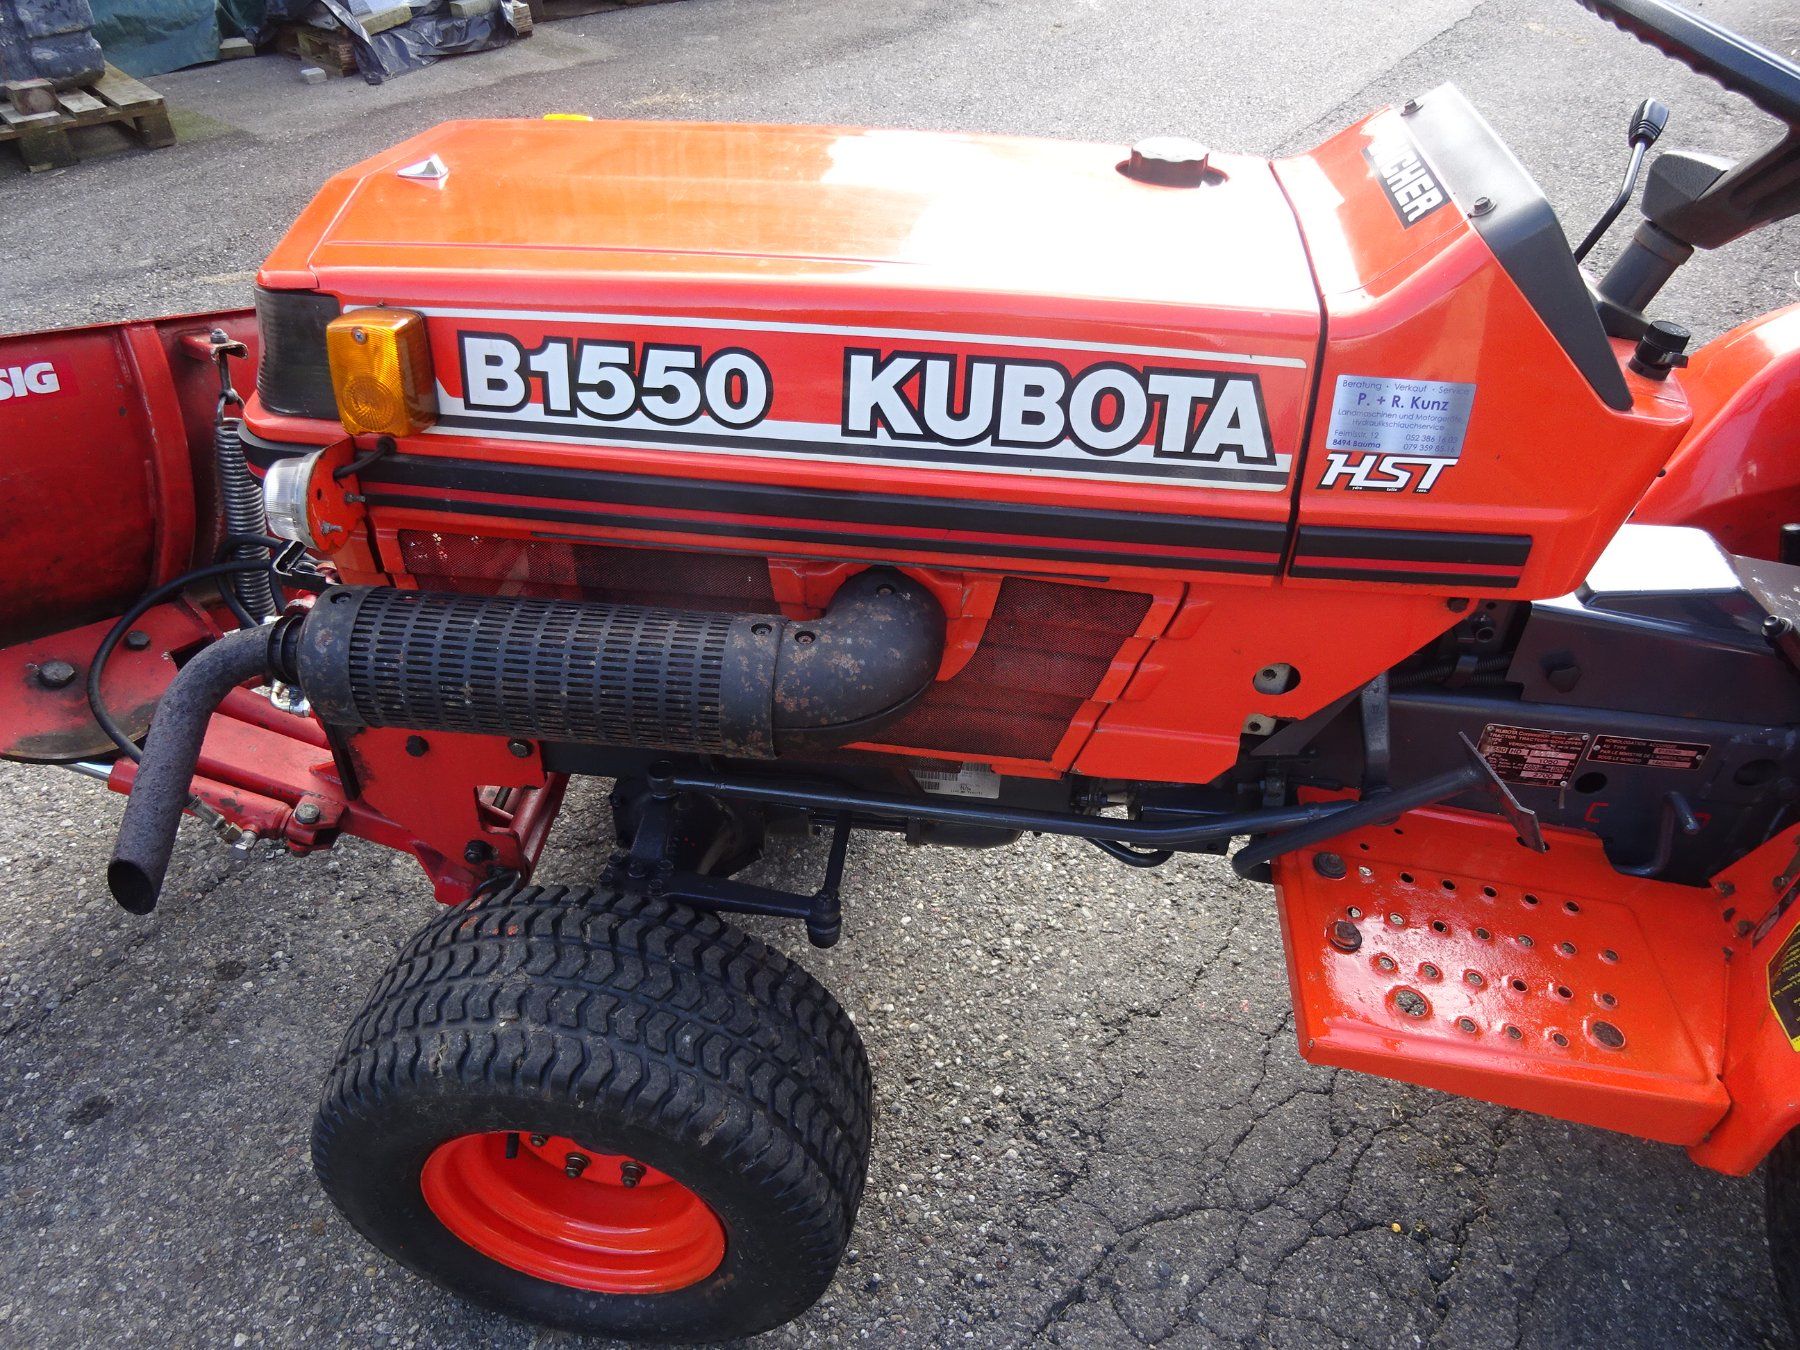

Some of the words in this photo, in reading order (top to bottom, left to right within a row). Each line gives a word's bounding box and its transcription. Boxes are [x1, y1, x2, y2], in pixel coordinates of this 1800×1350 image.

[1369, 138, 1444, 222] CHER
[1342, 379, 1382, 391] Beratung
[1394, 382, 1427, 393] Verkauf
[1438, 385, 1470, 396] Service
[457, 330, 773, 430] B1550
[842, 347, 1277, 466] KUBOTA
[1357, 392, 1370, 406] P.
[1391, 394, 1404, 409] R.
[1410, 395, 1449, 412] Kunz
[1337, 409, 1398, 419] Landmaschinen
[1398, 411, 1414, 421] und
[1352, 440, 1381, 448] Bauma
[1405, 434, 1420, 442] 052
[1421, 435, 1435, 443] 386
[1403, 443, 1417, 451] 079
[1419, 444, 1434, 452] 359
[1317, 452, 1459, 492] HST
